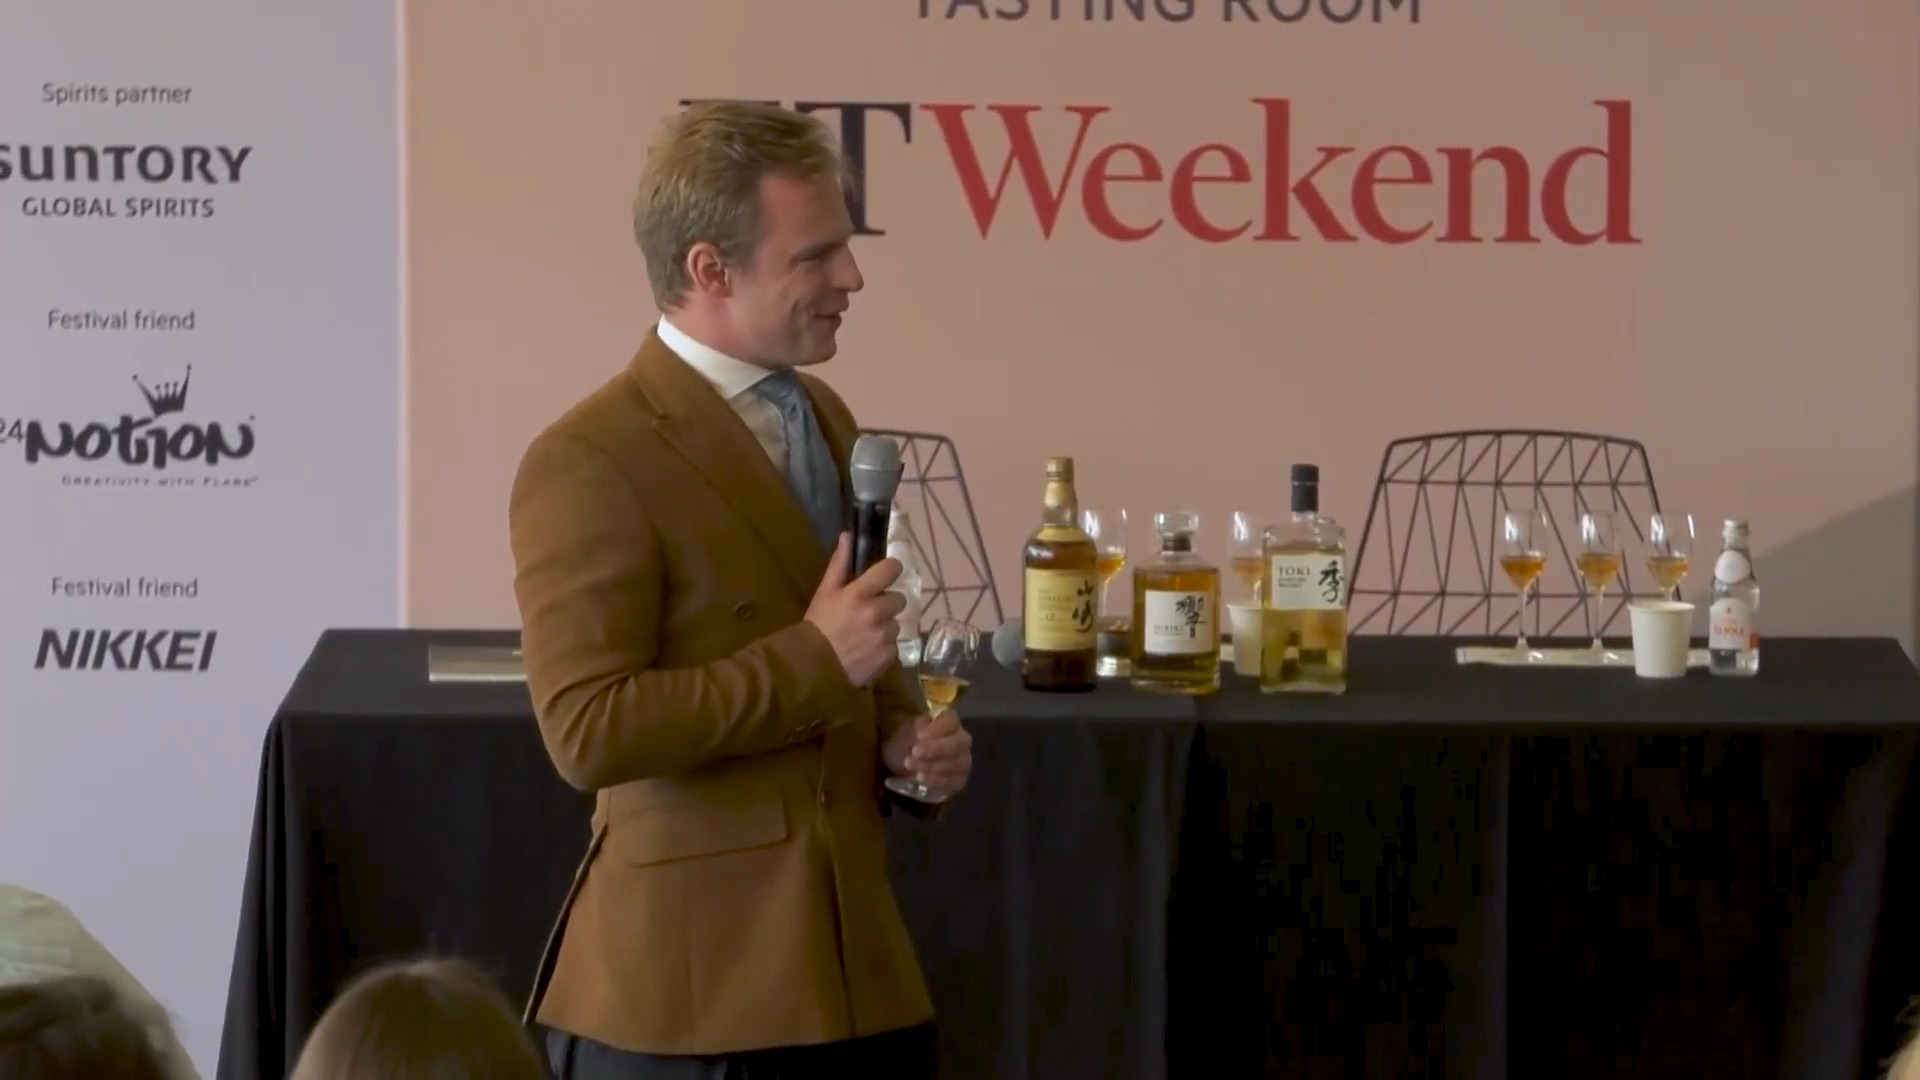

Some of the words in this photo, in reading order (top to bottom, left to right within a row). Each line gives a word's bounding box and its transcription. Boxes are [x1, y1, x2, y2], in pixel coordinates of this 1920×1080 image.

[1223, 0, 1420, 23] ROOM
[42, 82, 109, 106] Spirits
[115, 84, 193, 106] partner
[22, 196, 117, 217] GLOBAL
[125, 197, 215, 218] SPIRITS
[48, 309, 128, 330] Festival
[134, 309, 196, 330] friend
[1278, 566, 1310, 576] TOKI
[52, 576, 131, 597] Festival
[138, 576, 199, 598] friend
[34, 628, 218, 671] NIKKEI
